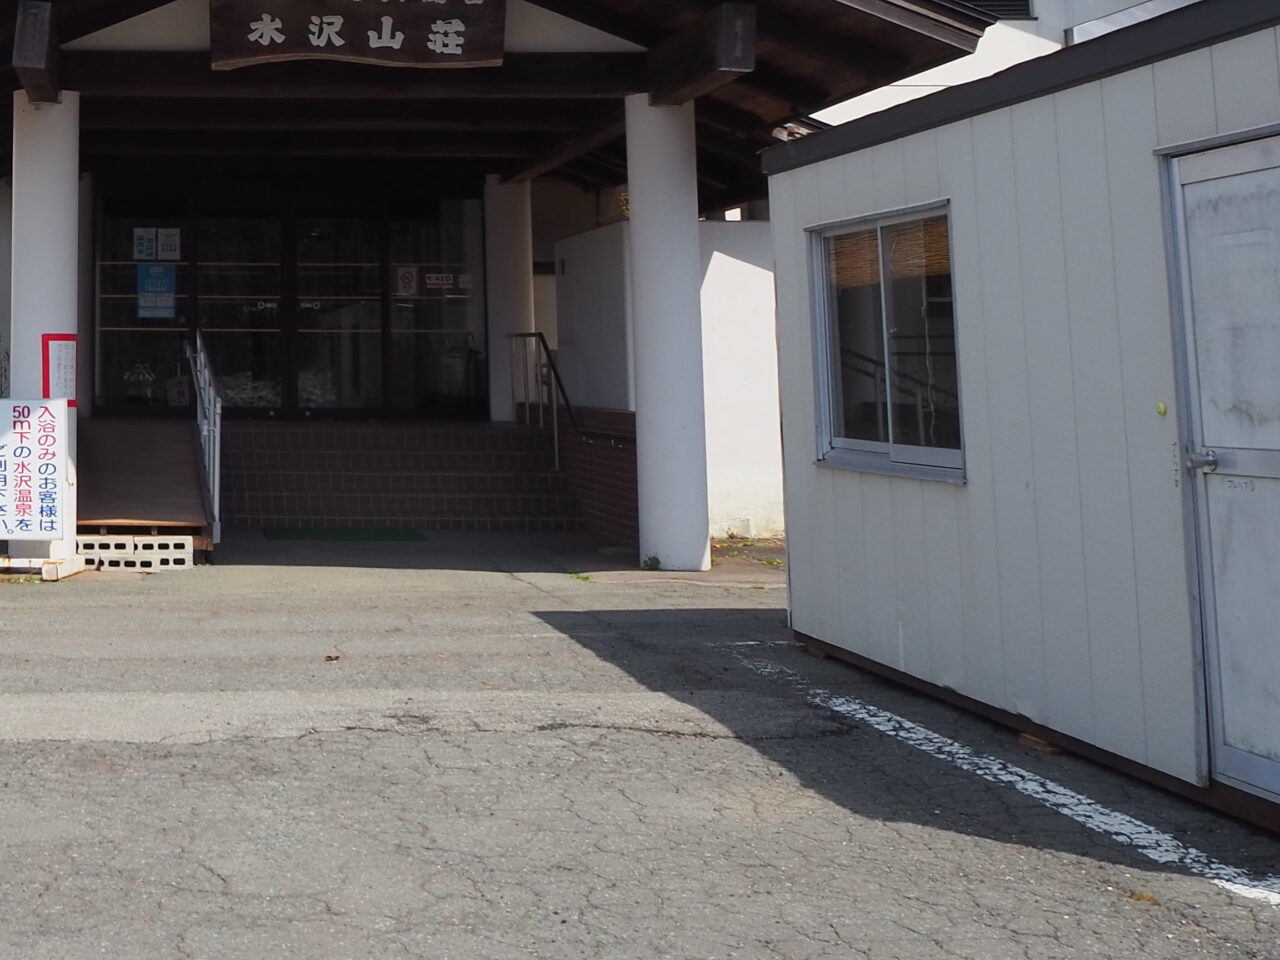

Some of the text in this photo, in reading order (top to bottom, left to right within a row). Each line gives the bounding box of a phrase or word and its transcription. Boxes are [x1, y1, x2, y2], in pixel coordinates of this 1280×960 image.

[247, 13, 466, 54] 水沢山荘
[37, 405, 58, 532] 入浴のみのお客様は
